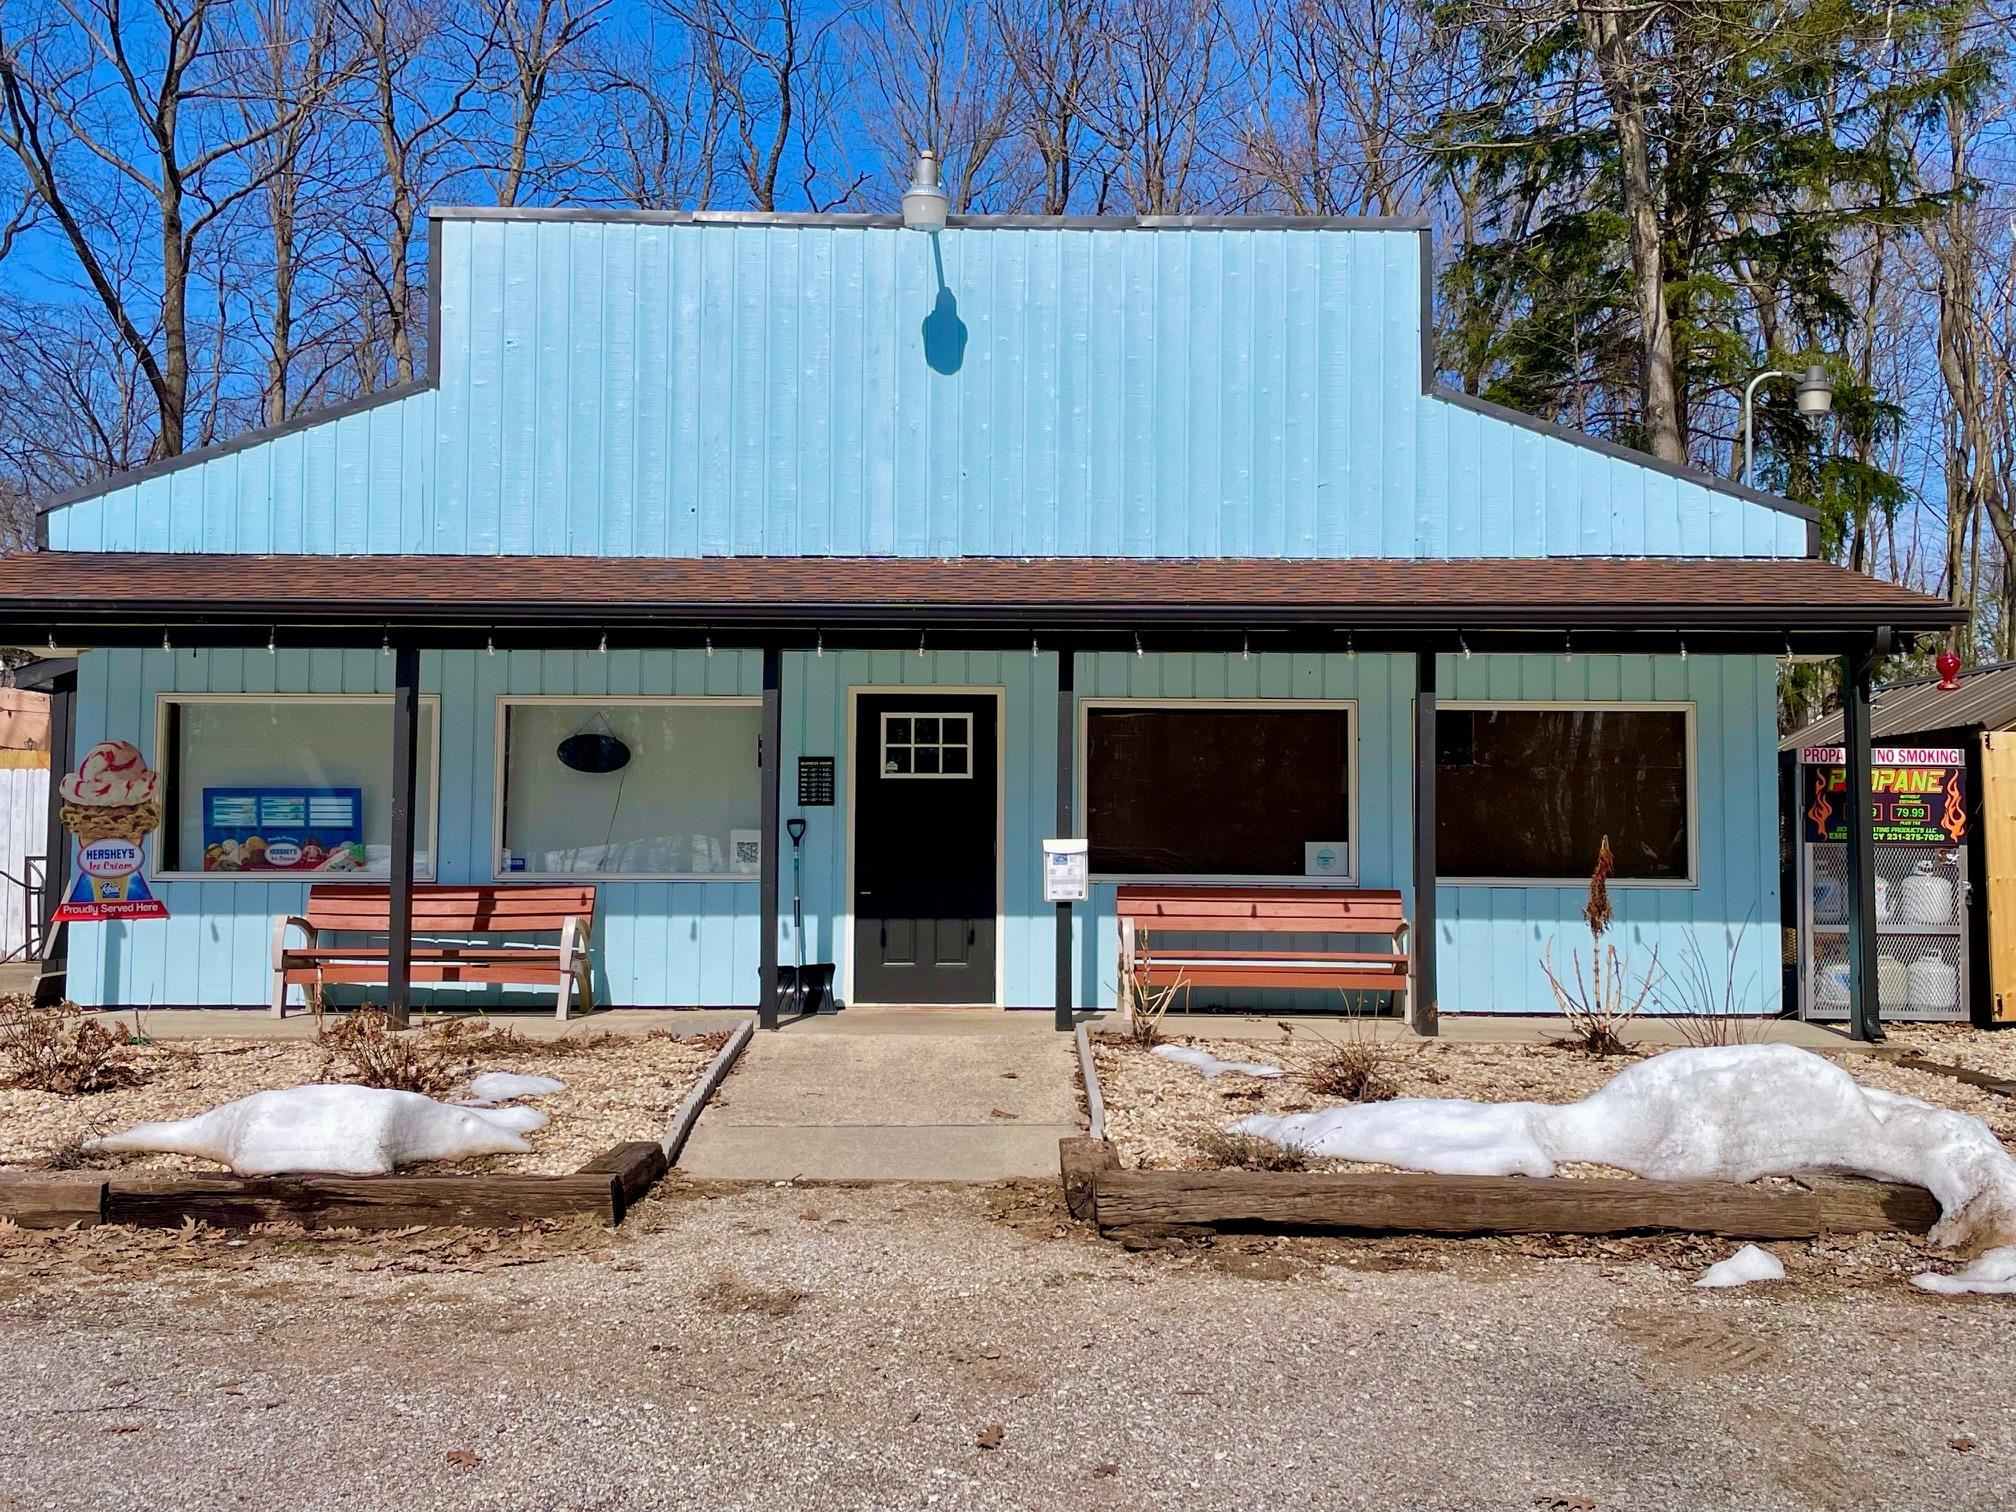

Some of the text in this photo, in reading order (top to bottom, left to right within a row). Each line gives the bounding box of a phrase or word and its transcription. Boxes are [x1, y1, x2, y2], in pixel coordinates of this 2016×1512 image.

[1804, 748, 1958, 764] PROPA NO SMOKING
[1896, 807, 1925, 818] 79.99
[1886, 833, 1946, 841] 231-275-7029
[86, 848, 135, 860] HERSHEY'S
[89, 861, 132, 871] Ice Cream
[63, 902, 159, 916] Proudly Served Here
